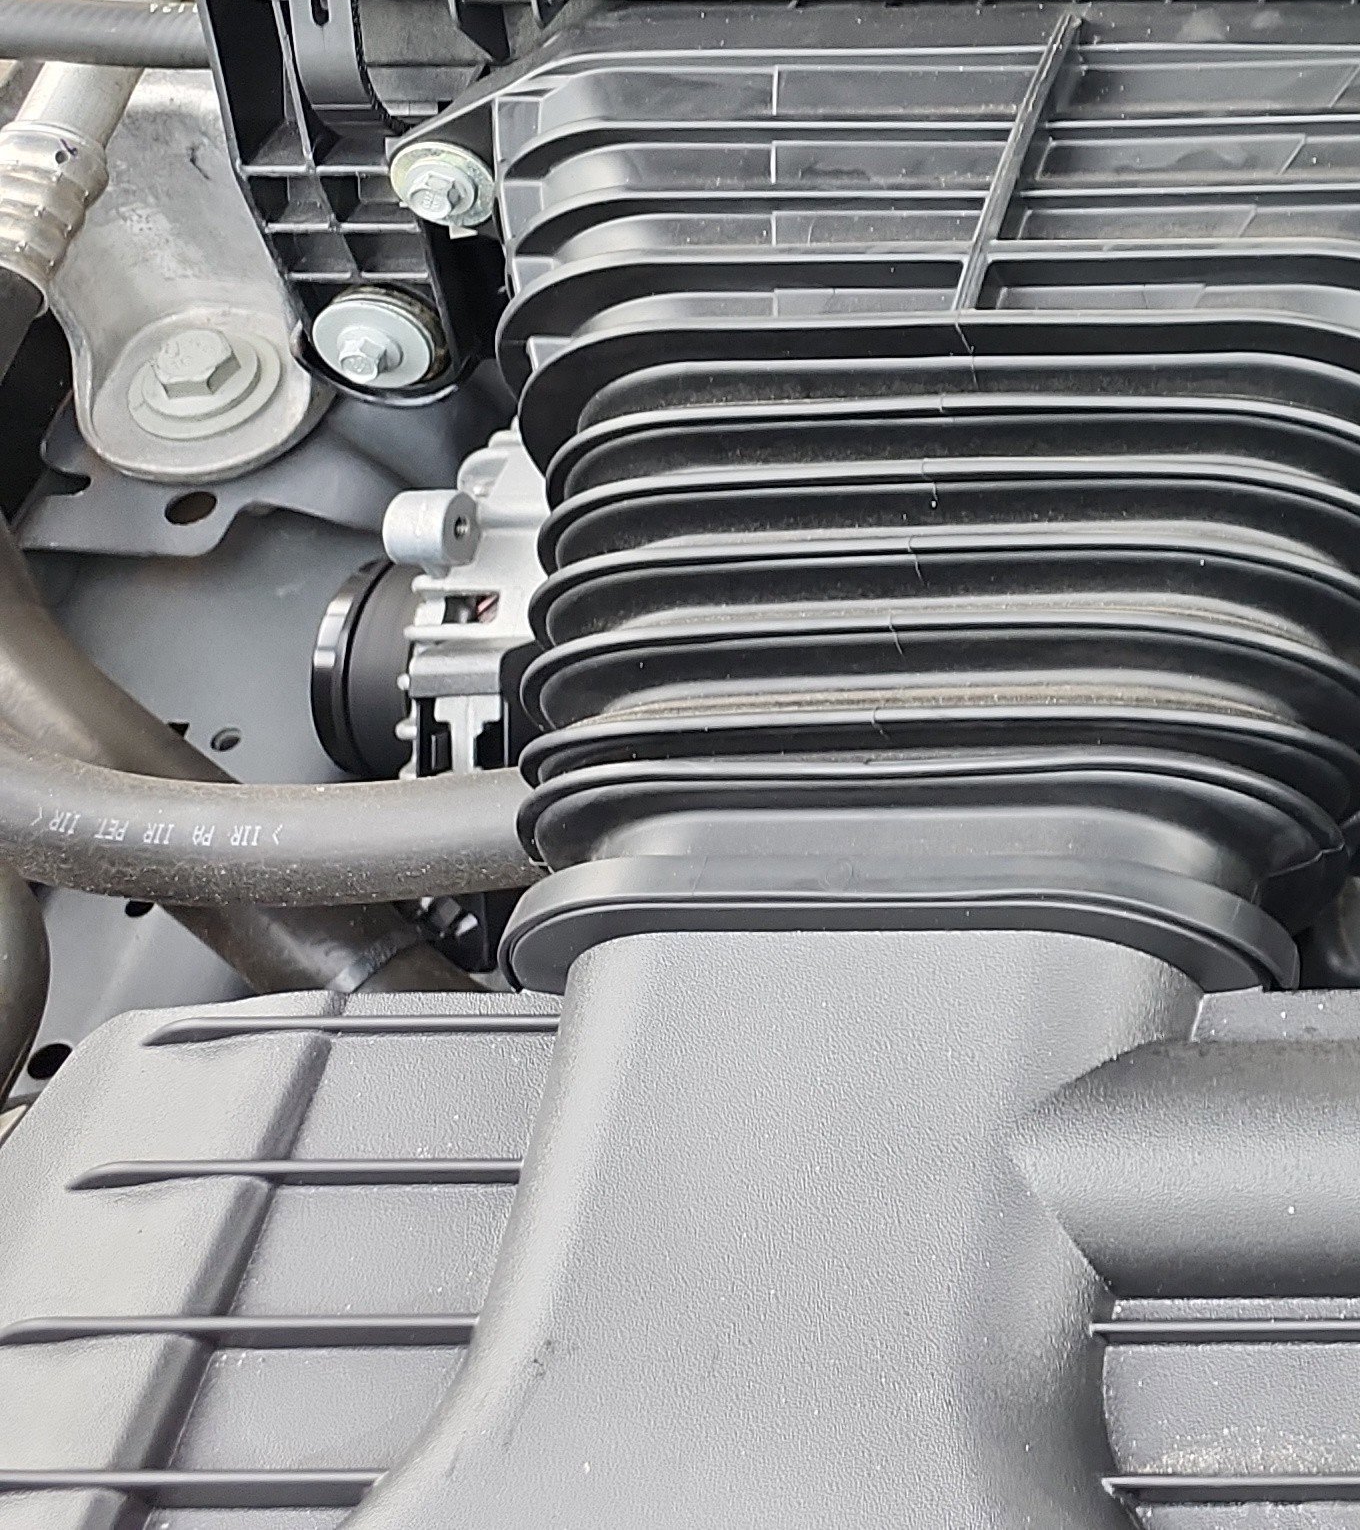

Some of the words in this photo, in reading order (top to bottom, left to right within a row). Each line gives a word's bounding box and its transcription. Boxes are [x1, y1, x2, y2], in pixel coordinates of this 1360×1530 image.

[94, 817, 130, 841] PET
[143, 823, 175, 845] IIR
[191, 824, 216, 847] PA
